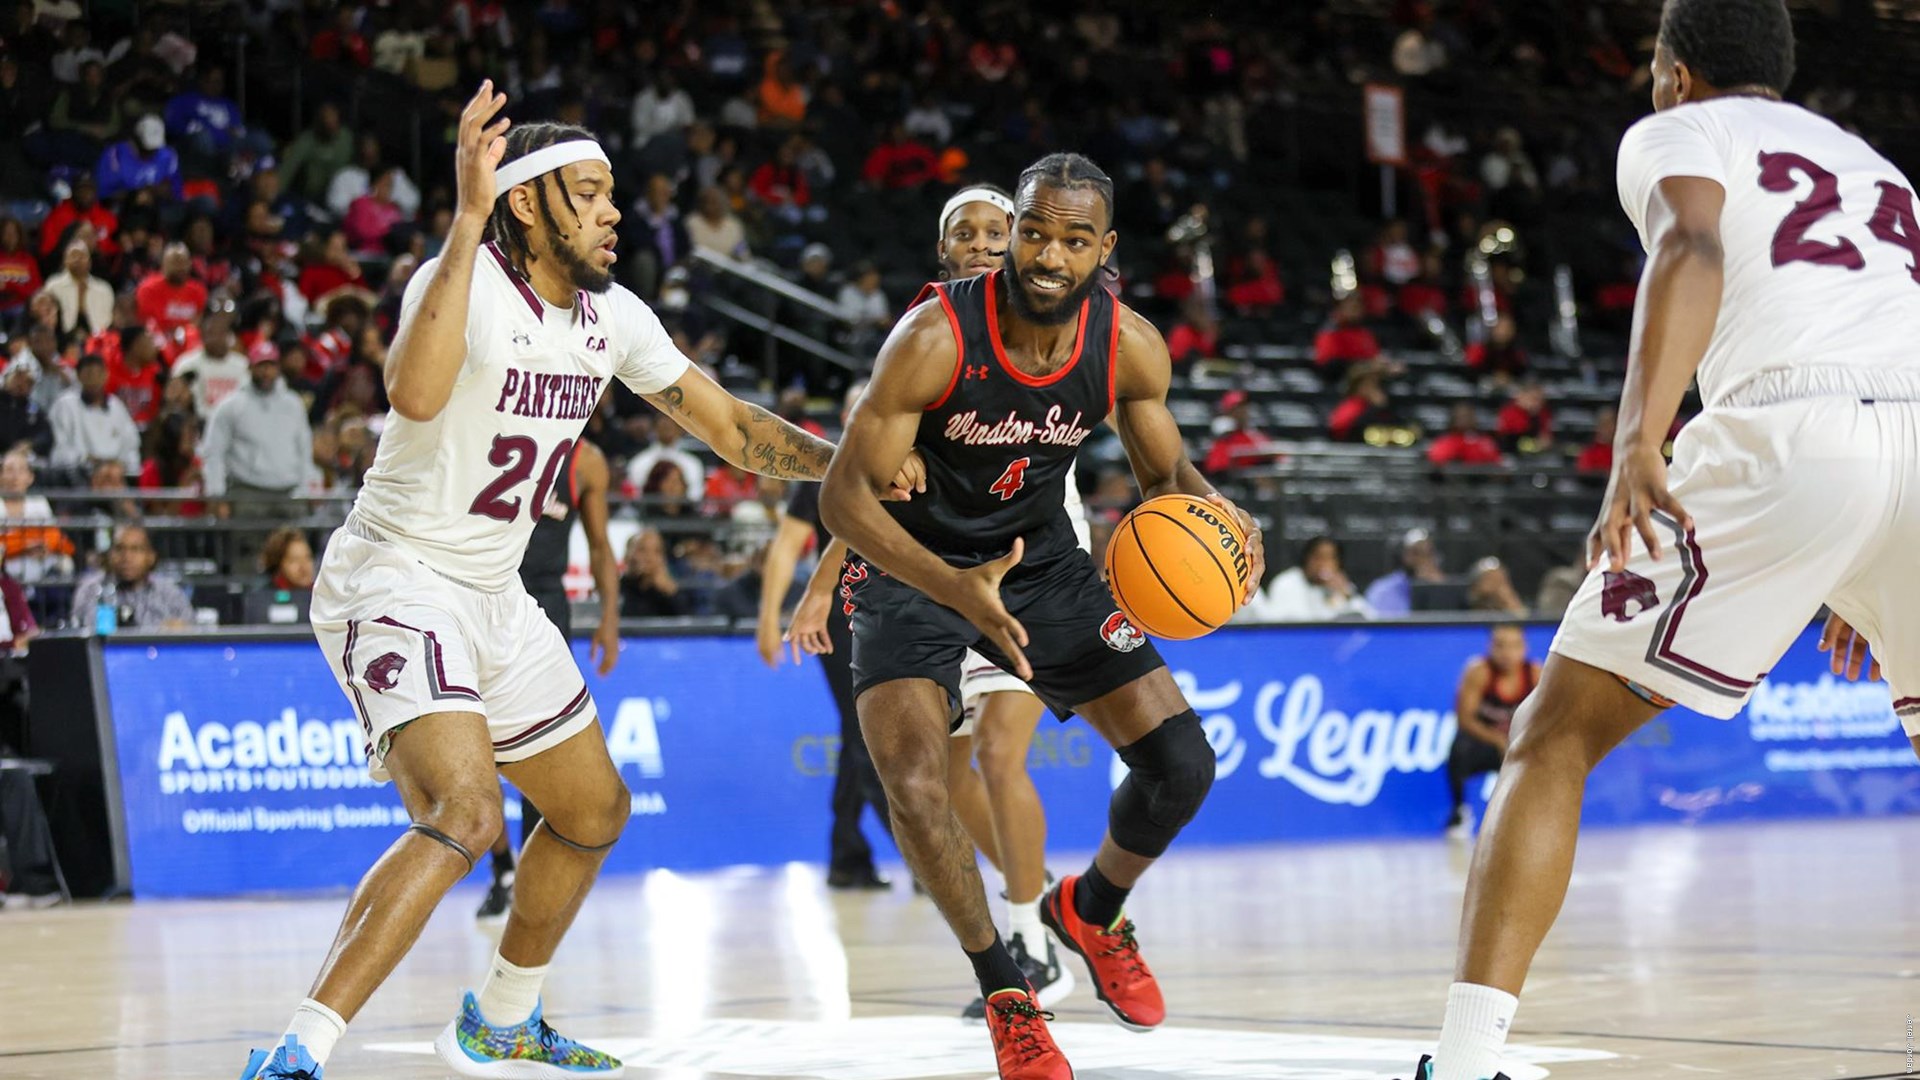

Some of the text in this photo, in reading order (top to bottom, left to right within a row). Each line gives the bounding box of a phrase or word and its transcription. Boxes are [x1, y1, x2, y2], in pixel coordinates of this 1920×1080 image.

[1757, 149, 1920, 285] 24
[495, 368, 603, 420] PANTHERS
[989, 457, 1030, 501] 4
[1186, 503, 1249, 587] Wilson
[158, 707, 368, 770] Academ
[1254, 674, 1458, 806] Lega
[183, 808, 252, 834] Official
[253, 805, 334, 832] Sporting
[334, 802, 391, 827] Goods
